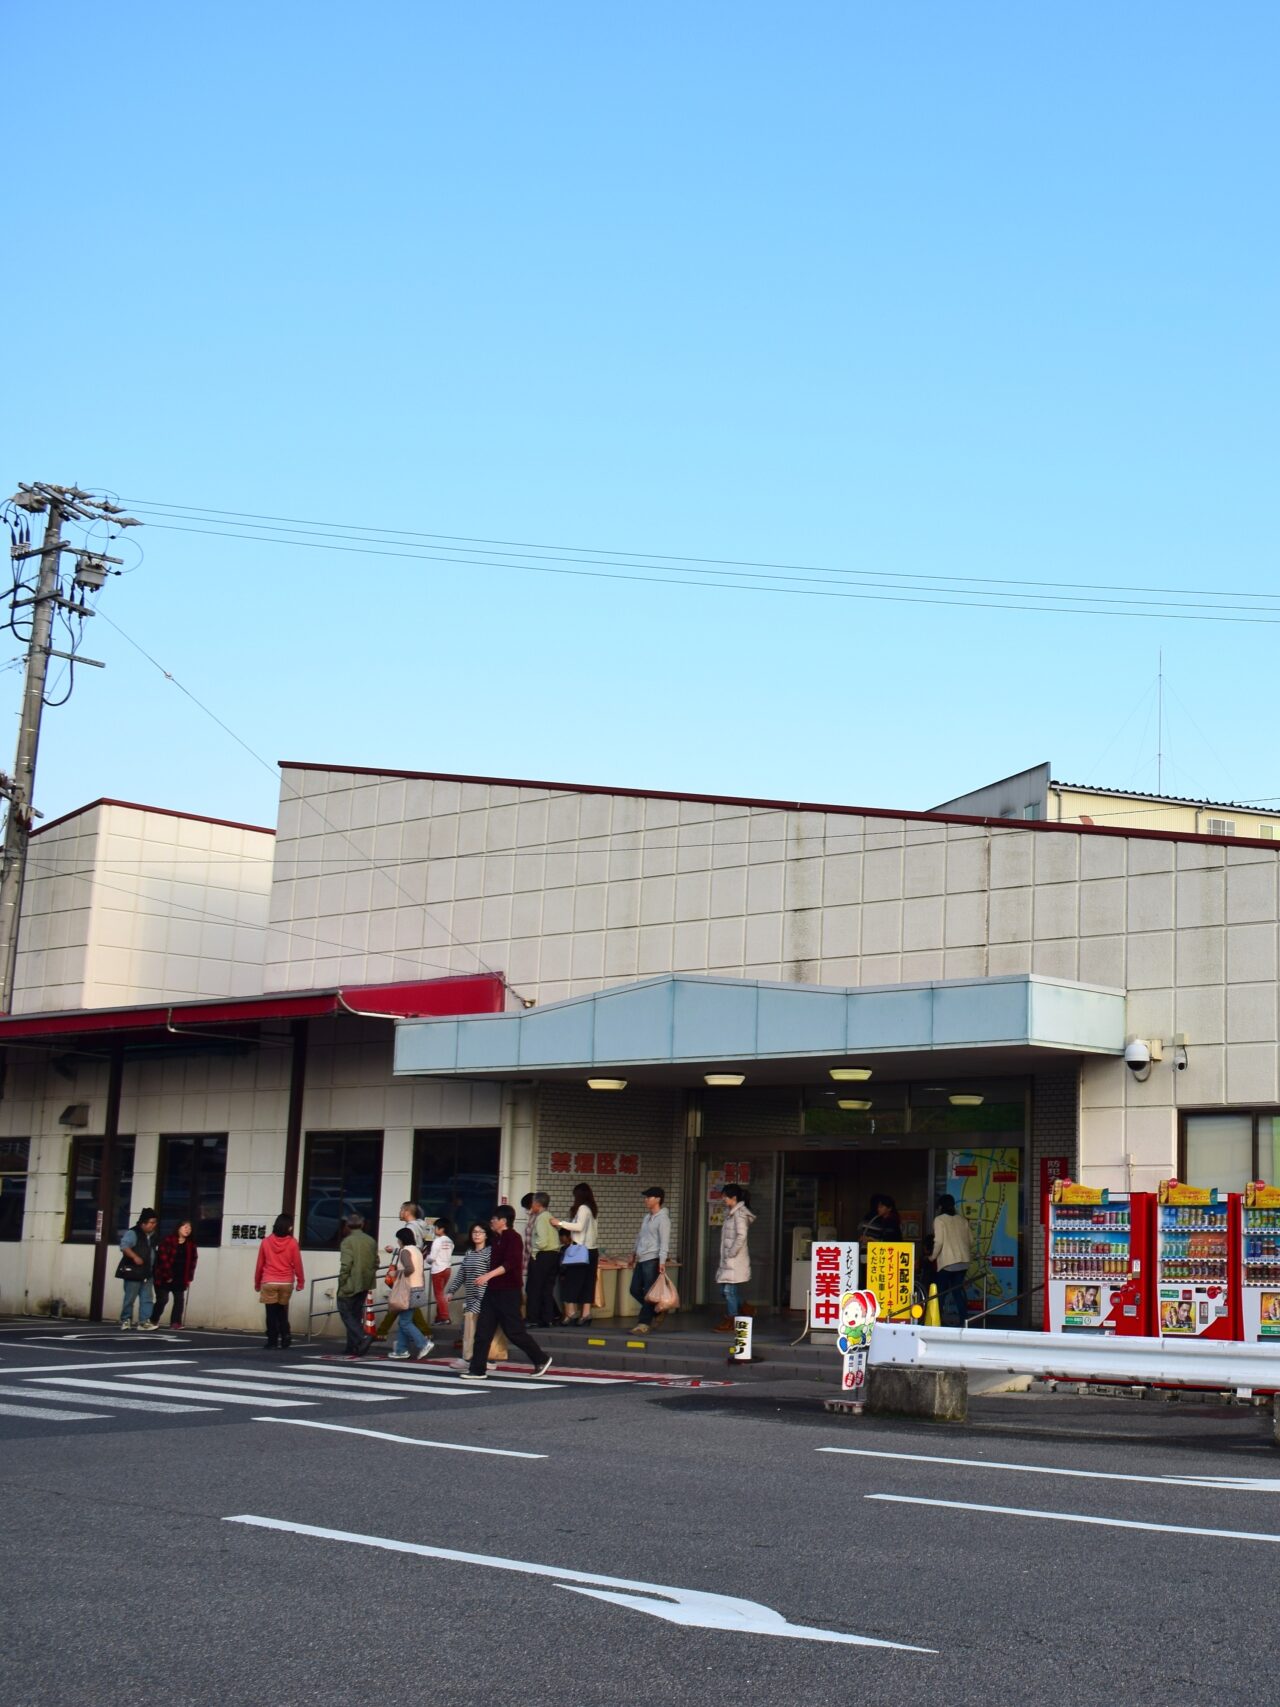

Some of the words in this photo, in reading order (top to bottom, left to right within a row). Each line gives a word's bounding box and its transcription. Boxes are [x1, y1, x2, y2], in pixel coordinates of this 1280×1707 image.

[551, 1152, 639, 1174] 禁煙区域
[231, 1225, 267, 1239] 禁煙区域
[815, 1247, 841, 1325] 営業中
[870, 1247, 878, 1283] ください
[878, 1248, 887, 1310] かけて駐車して
[899, 1252, 910, 1305] 勾配あり
